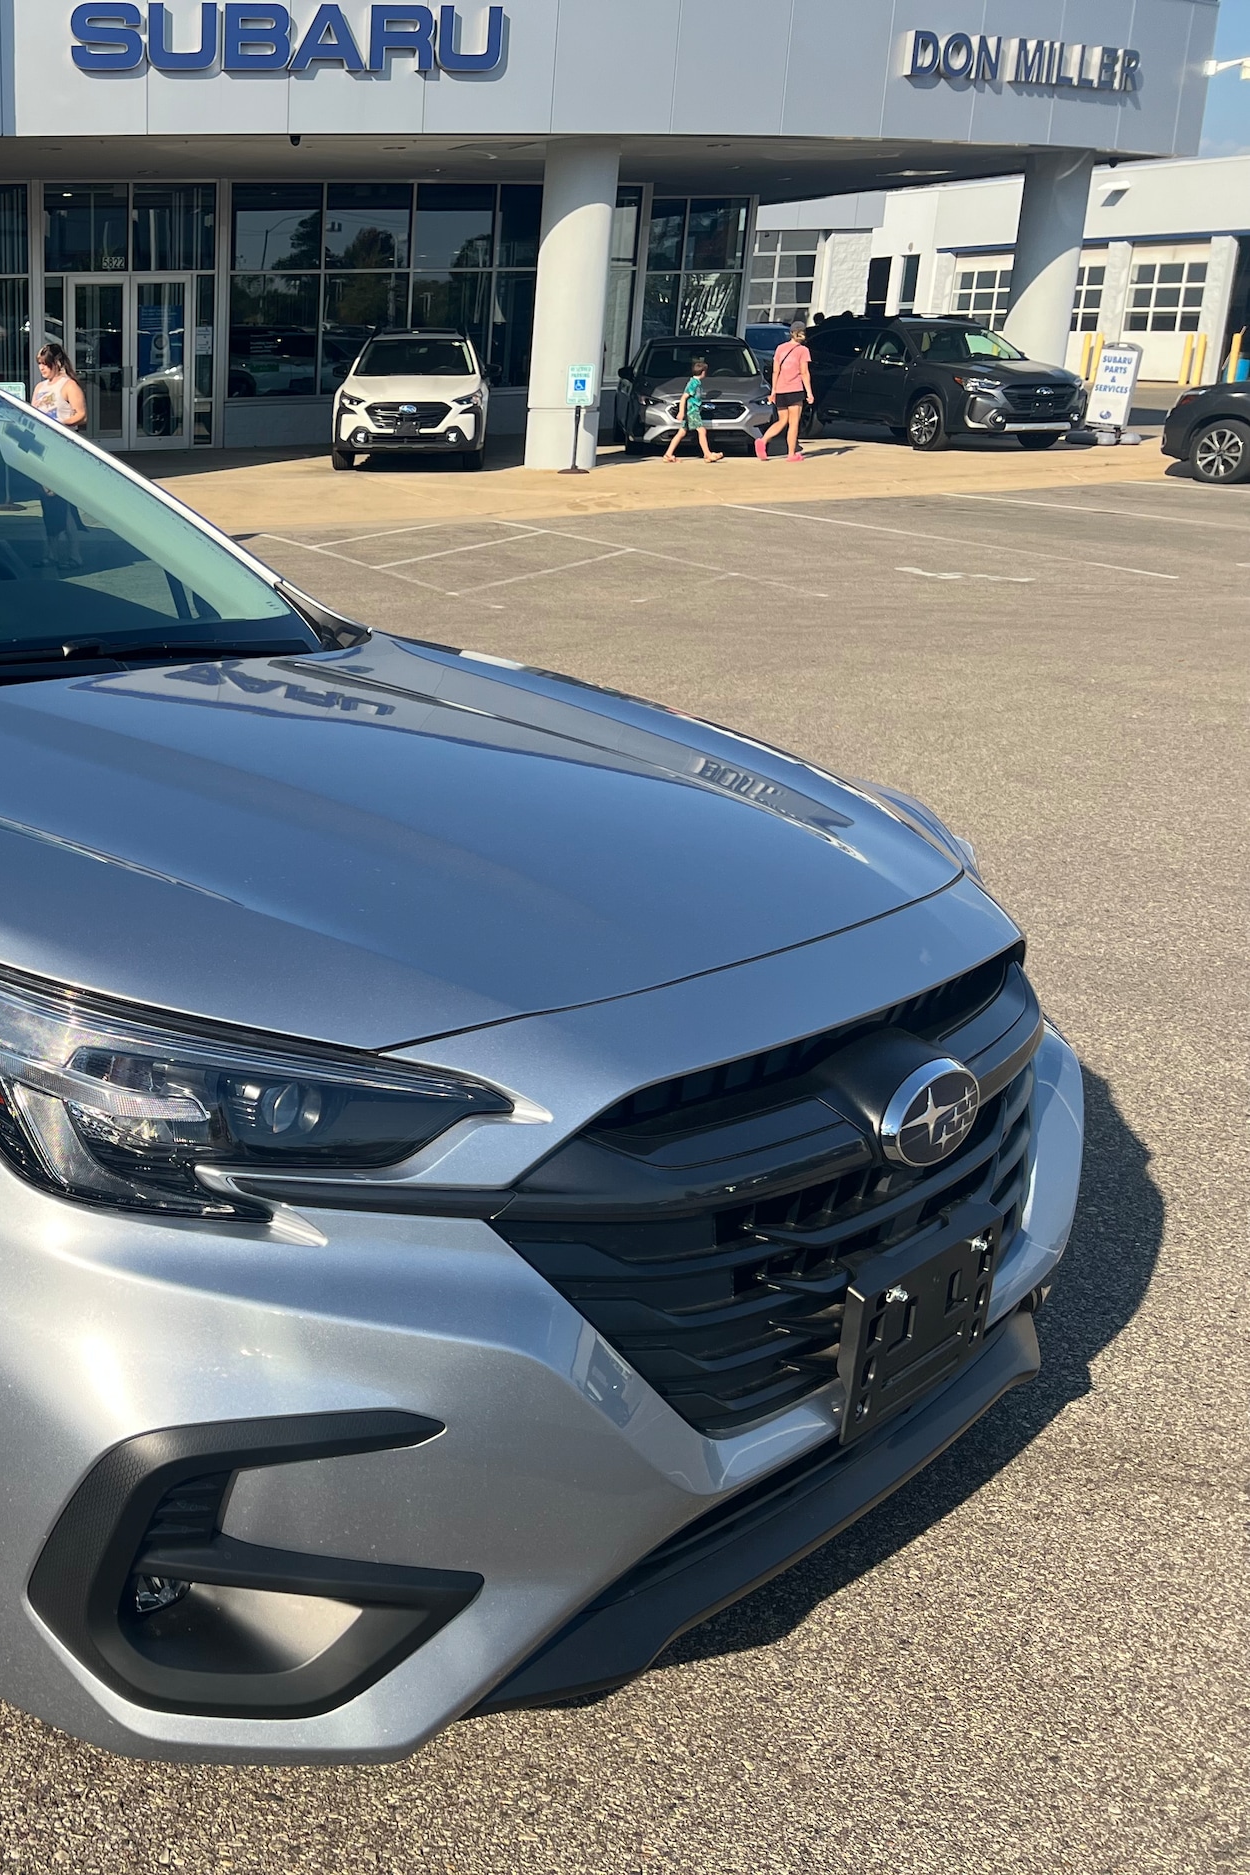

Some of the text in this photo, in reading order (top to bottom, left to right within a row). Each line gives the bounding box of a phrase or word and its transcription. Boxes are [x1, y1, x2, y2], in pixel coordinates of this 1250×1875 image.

[70, 2, 504, 71] SUBARU
[904, 30, 1141, 91] DON MILLER
[102, 256, 125, 269] 5822
[1102, 355, 1133, 365] SUBARU
[1104, 365, 1128, 374] PARTS
[1095, 384, 1129, 394] SERVICES
